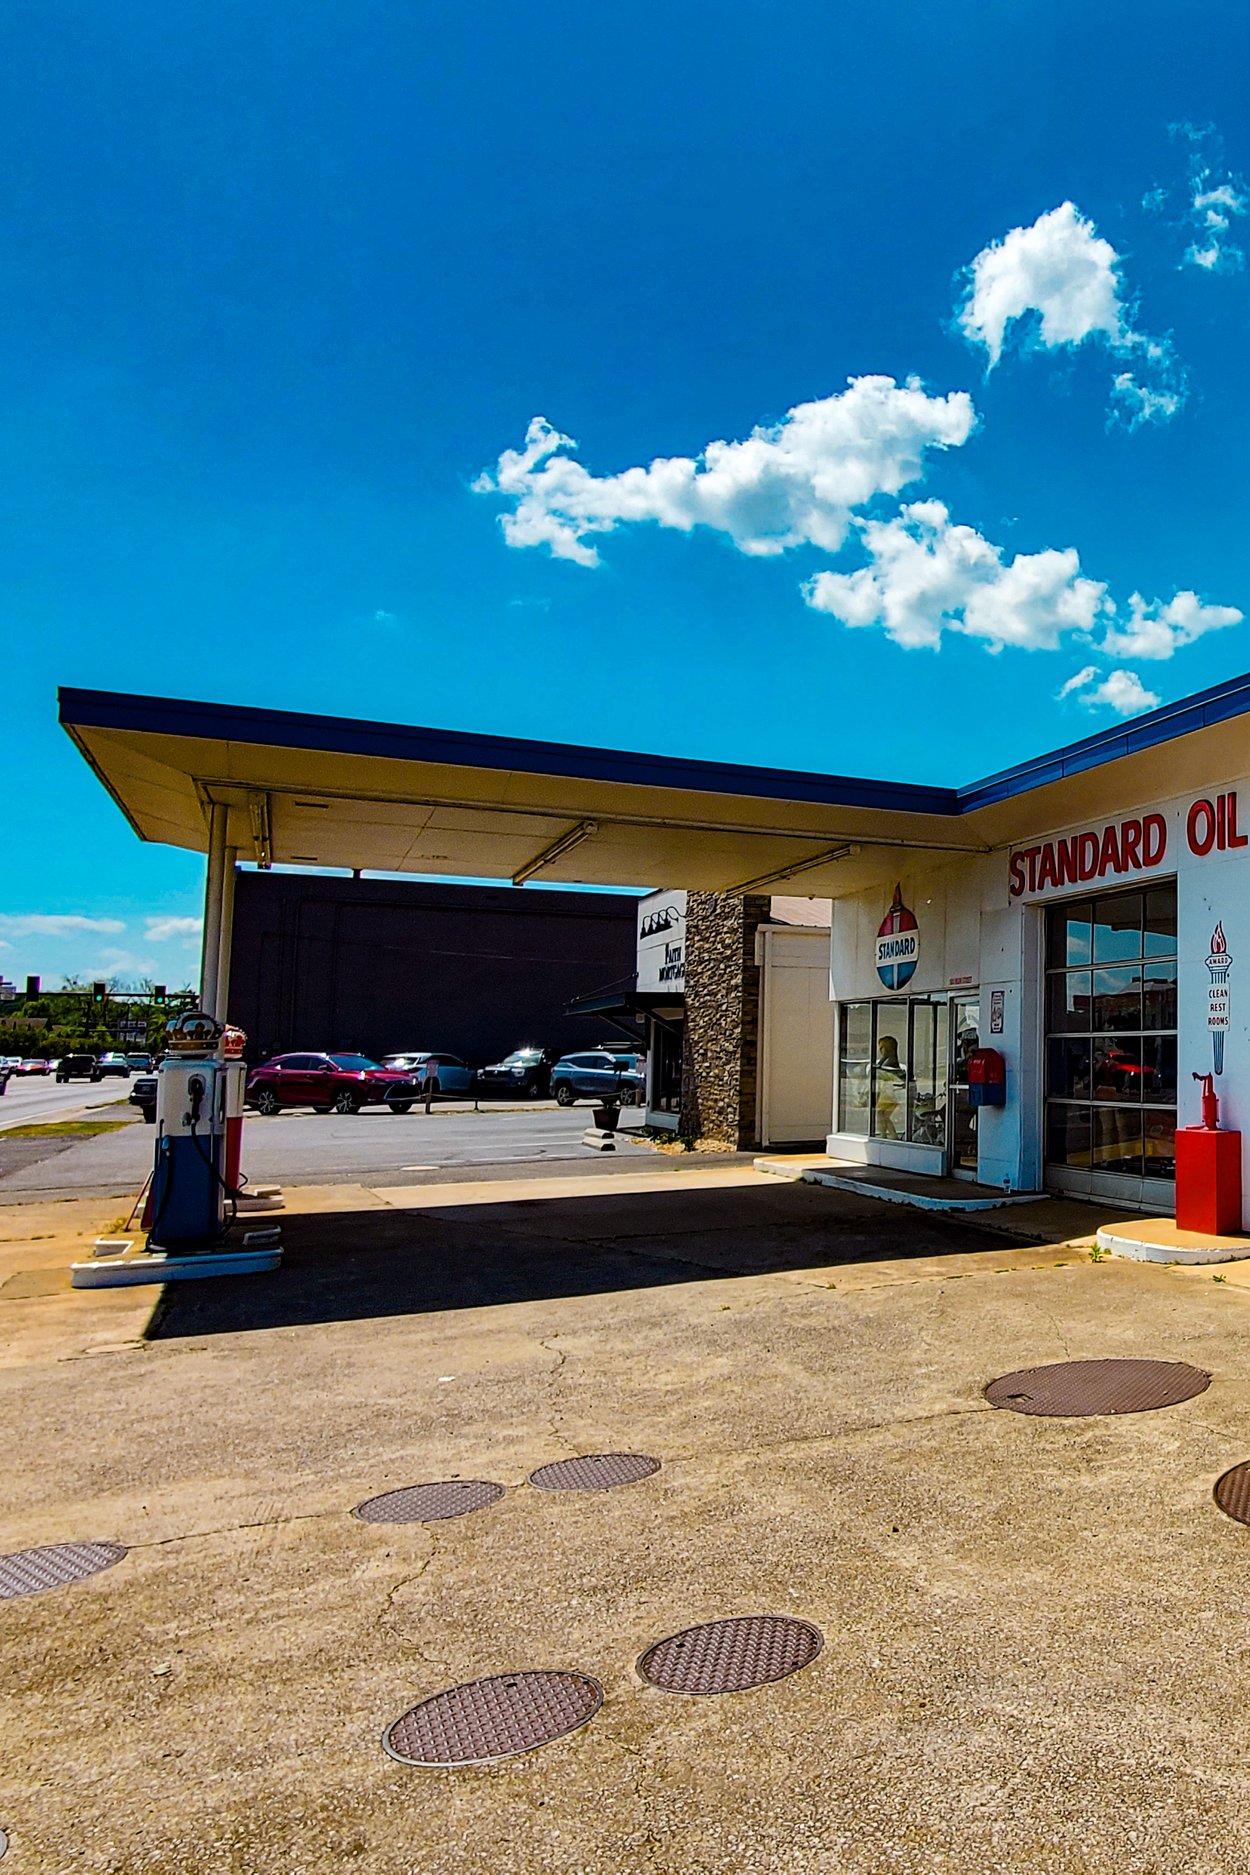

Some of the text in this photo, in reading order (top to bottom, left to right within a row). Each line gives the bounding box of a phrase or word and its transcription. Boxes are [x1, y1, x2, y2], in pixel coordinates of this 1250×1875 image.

[1009, 813, 1168, 897] STANDARD
[1187, 791, 1248, 857] OIL
[878, 937, 916, 960] STANDARD
[1209, 957, 1228, 965] AWARD
[1208, 989, 1228, 999] CLEAN
[1210, 1003, 1226, 1012] REST
[1208, 1016, 1229, 1026] ROOMS
